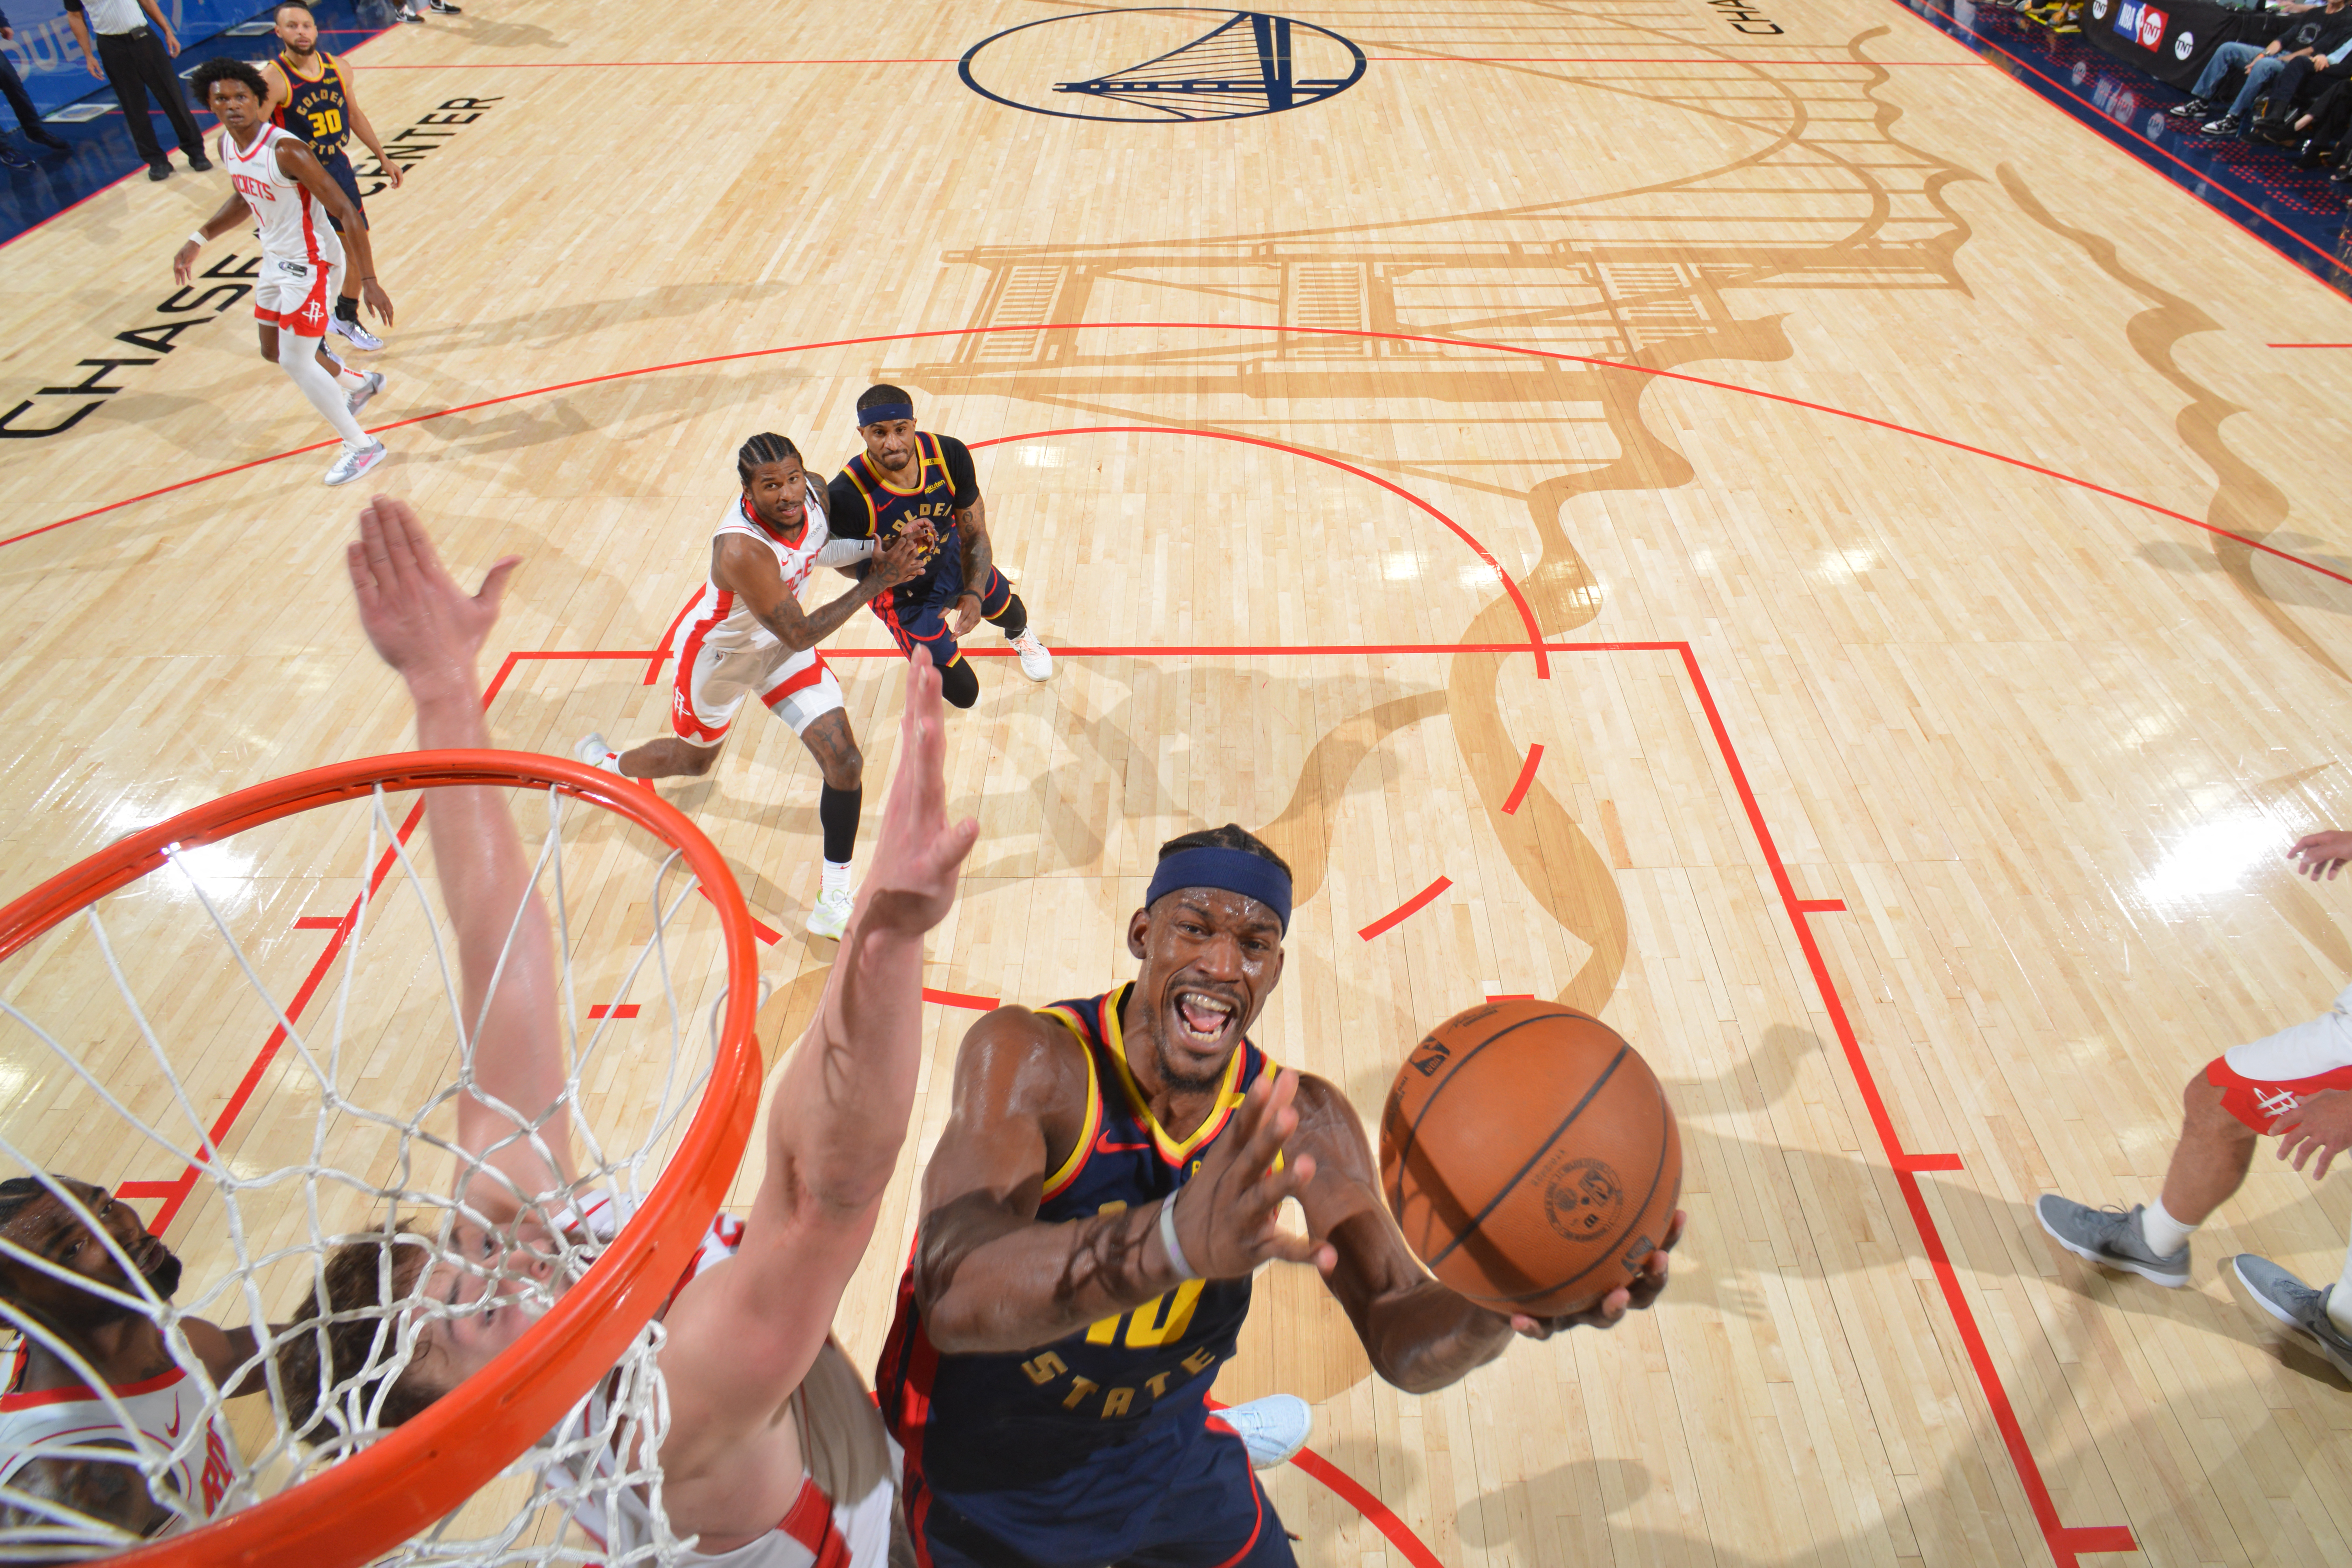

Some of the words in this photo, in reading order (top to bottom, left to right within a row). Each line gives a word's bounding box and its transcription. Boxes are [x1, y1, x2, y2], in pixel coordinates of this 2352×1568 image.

[2118, 3, 2136, 31] NBA
[2144, 23, 2160, 39] TNT
[2176, 40, 2192, 54] TNT
[296, 89, 345, 116] GOLDEN
[308, 108, 342, 138] 30
[308, 133, 348, 155] STATE
[231, 174, 276, 201] OCKETS
[1021, 1346, 1215, 1419] STATE
